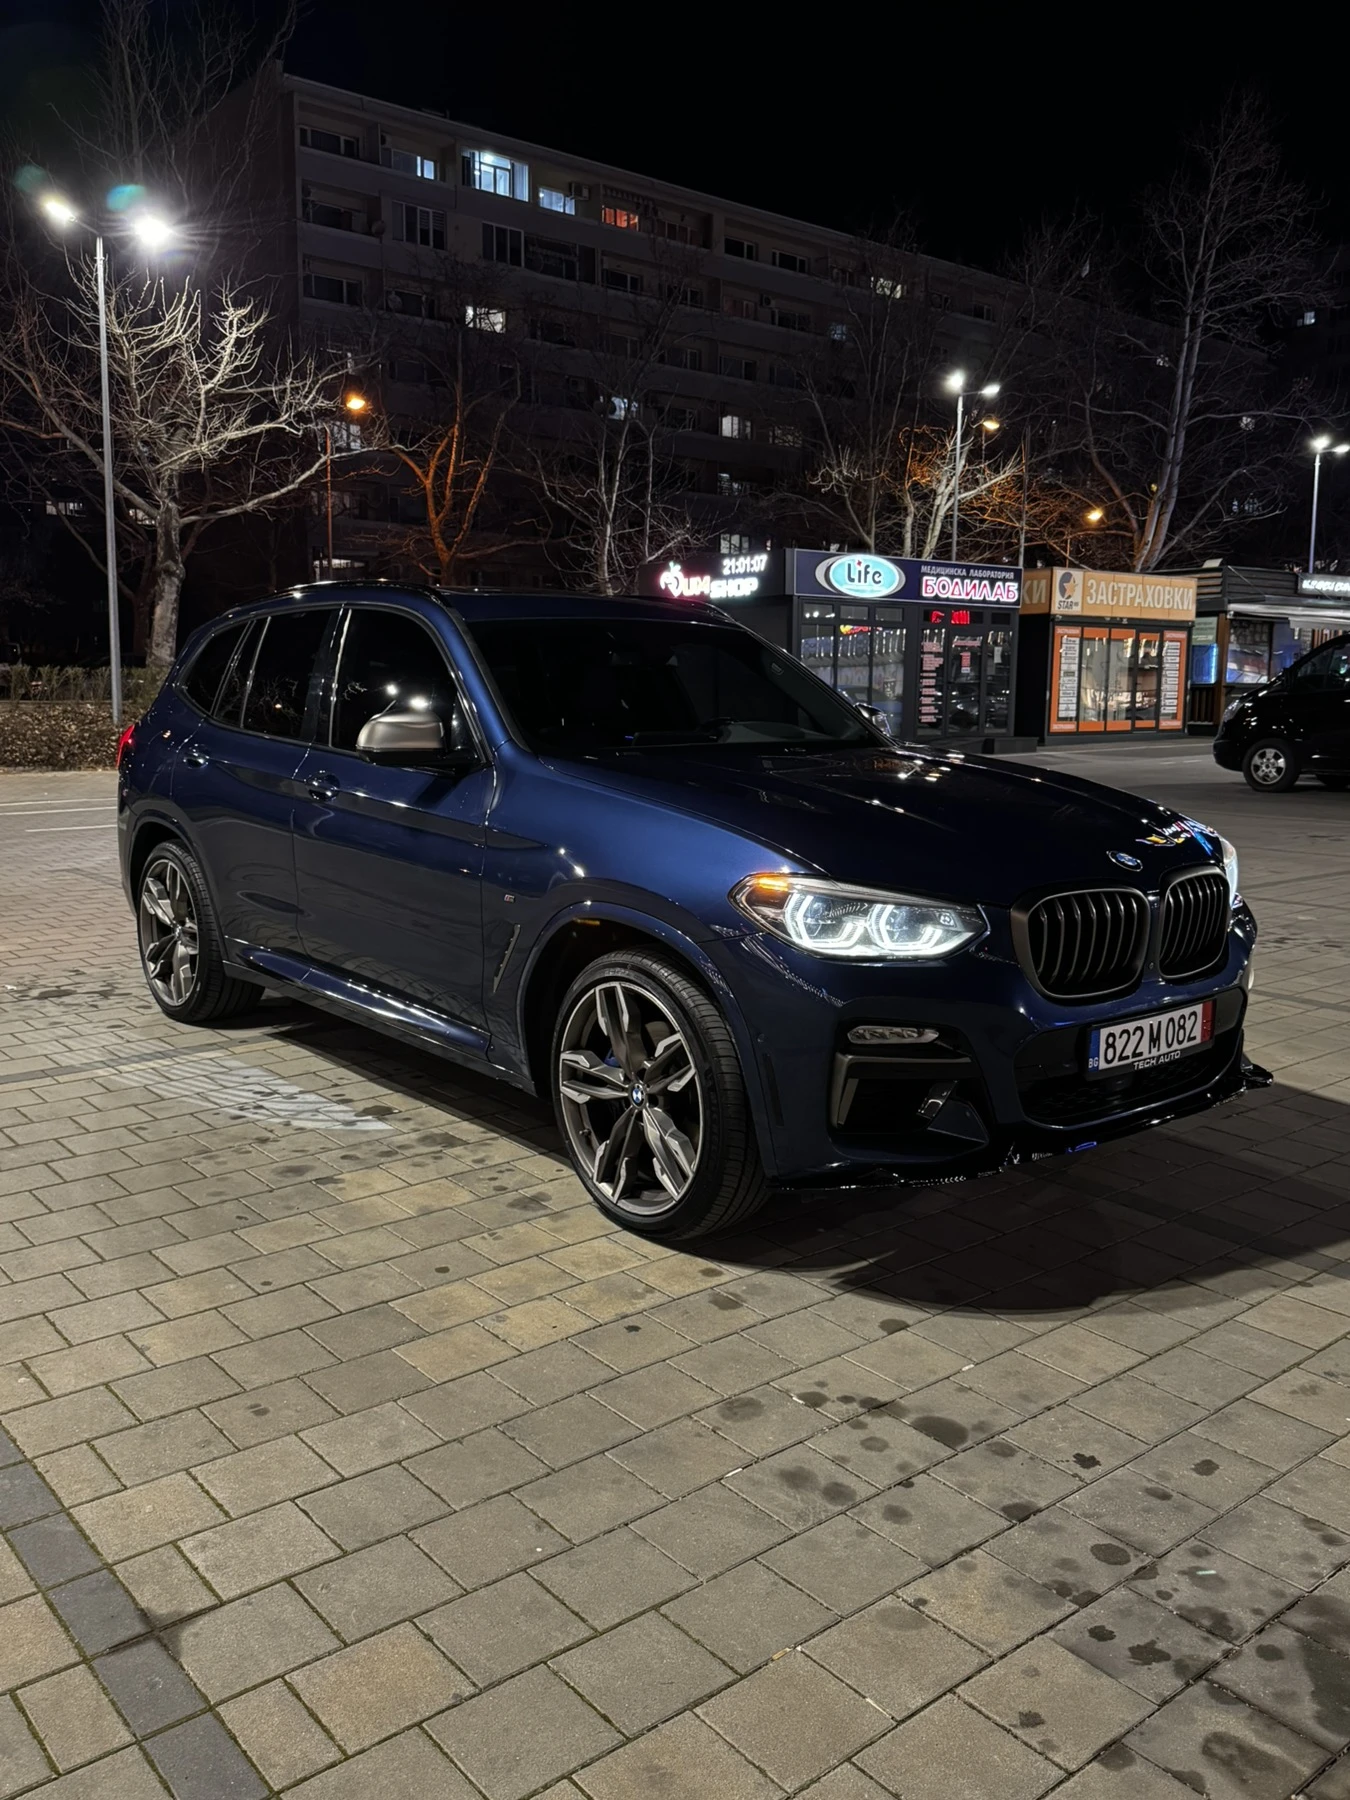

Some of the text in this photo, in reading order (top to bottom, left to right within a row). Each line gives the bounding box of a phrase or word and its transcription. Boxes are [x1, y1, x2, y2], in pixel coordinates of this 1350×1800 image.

[722, 554, 768, 576] 21:01:07
[847, 560, 882, 585] Life
[920, 565, 1015, 580] МЕДИЦИНСКА ЛАБОРАТОРИЯ
[922, 576, 1019, 603] БОДИЛАБ
[1086, 578, 1193, 611] ЗАСТРАХОВКИ
[1057, 600, 1074, 610] STAR
[1088, 1056, 1099, 1069] BG
[1133, 1050, 1181, 1071] TECH AUTO
